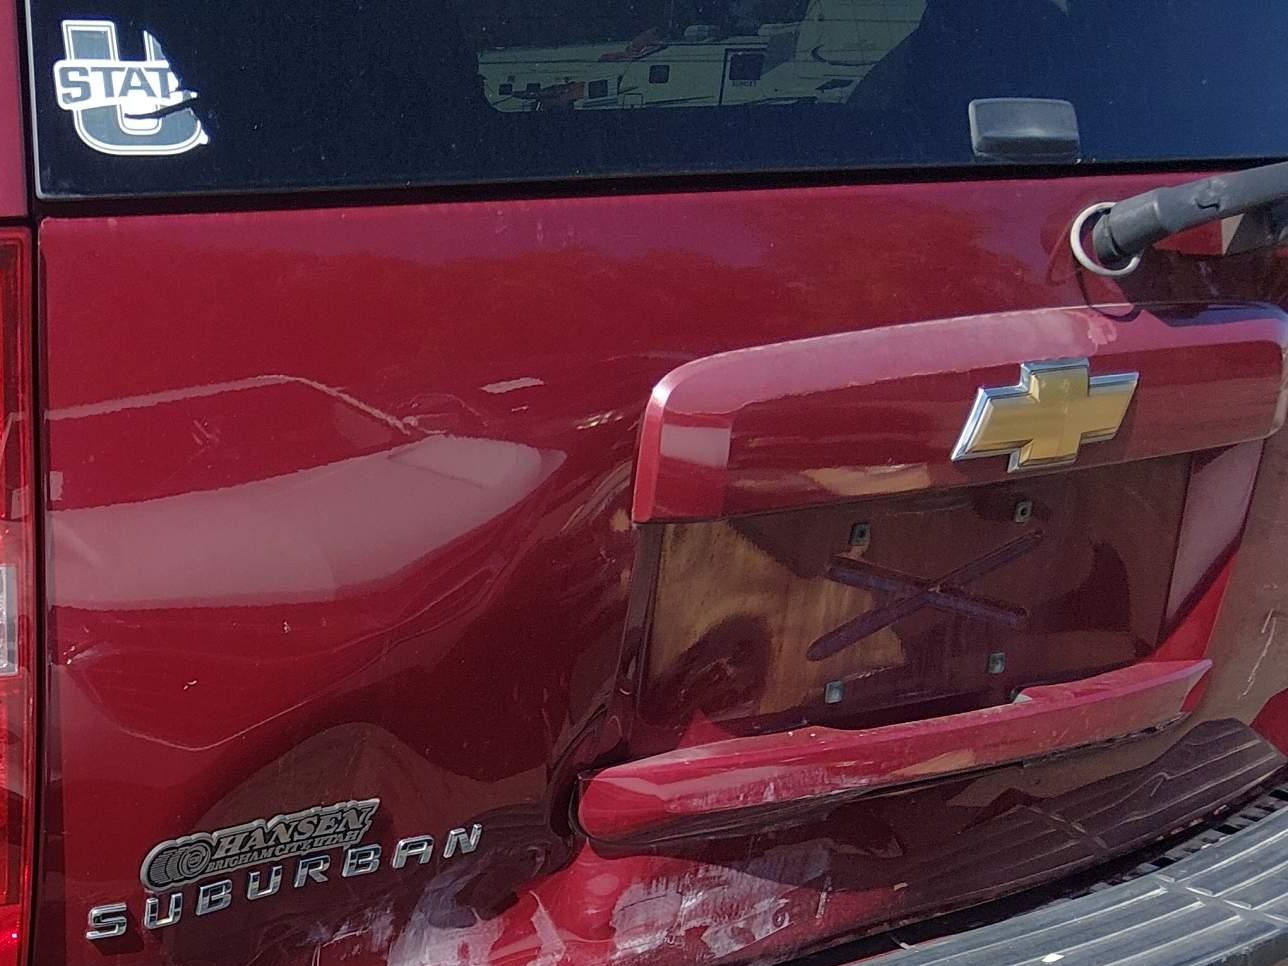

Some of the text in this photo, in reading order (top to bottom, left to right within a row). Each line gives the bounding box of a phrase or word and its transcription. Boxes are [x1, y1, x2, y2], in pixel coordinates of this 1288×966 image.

[59, 66, 190, 105] STAT
[206, 847, 275, 873] BRIGHAM
[312, 829, 361, 848] UTAH
[212, 806, 372, 860] HANSEN
[86, 823, 482, 940] SUBURBAN
